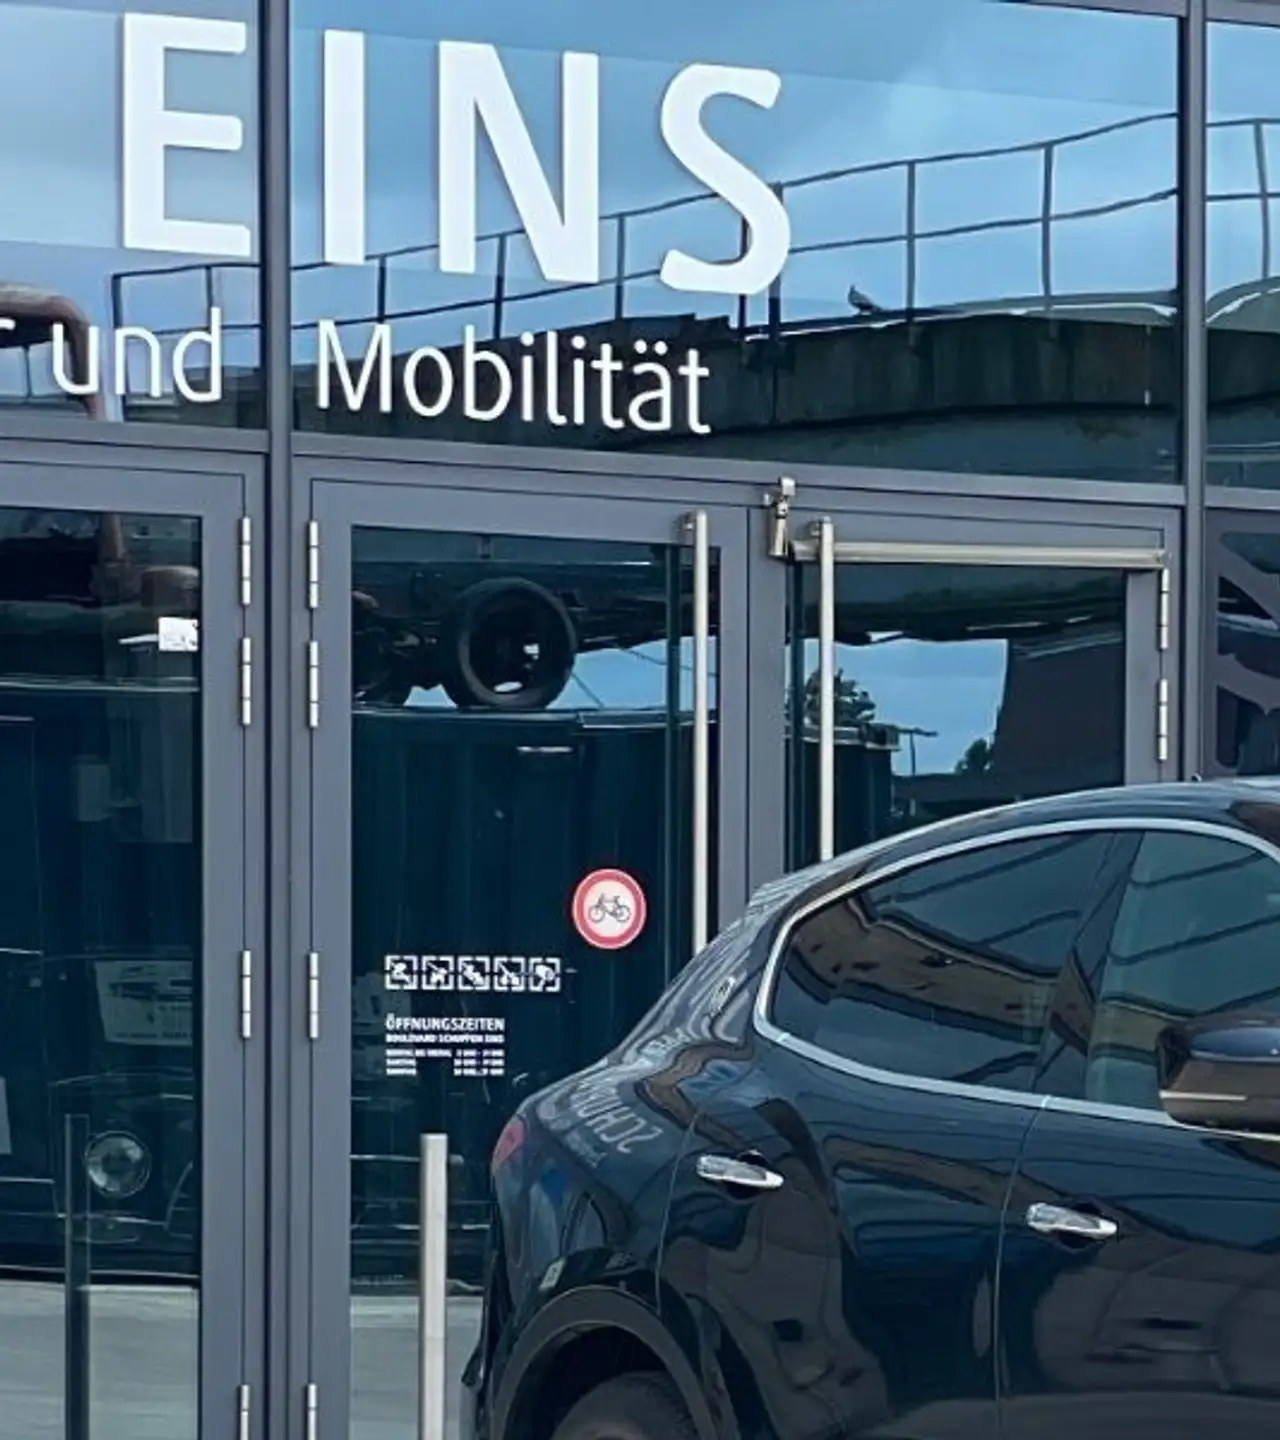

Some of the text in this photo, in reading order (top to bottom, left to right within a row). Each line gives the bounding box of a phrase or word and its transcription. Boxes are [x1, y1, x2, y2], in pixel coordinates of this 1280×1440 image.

[122, 12, 792, 296] EINS
[52, 306, 711, 434] und Mobilität
[385, 1013, 505, 1031] ÖFFNUNGSZEITEN
